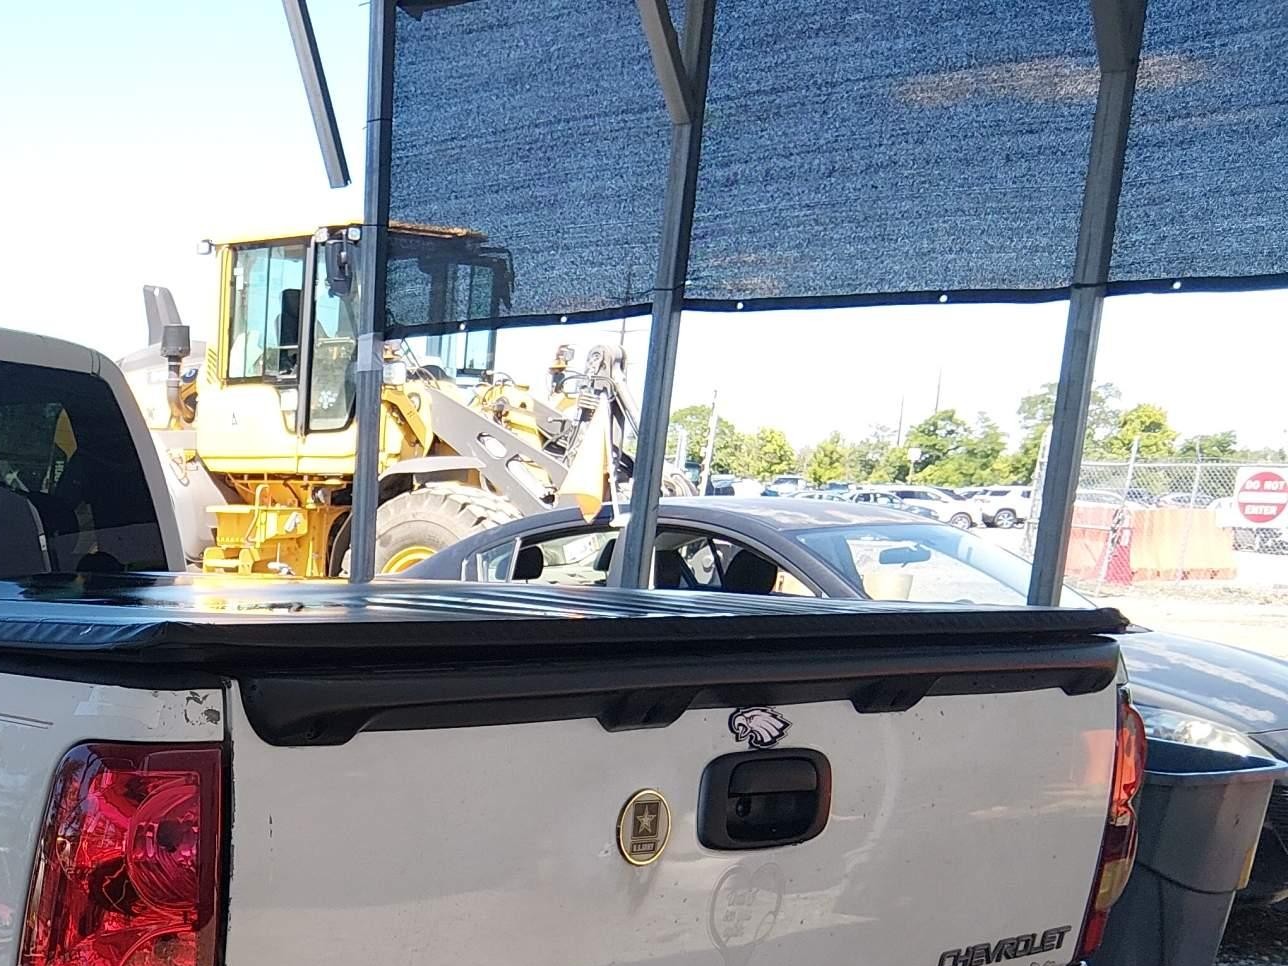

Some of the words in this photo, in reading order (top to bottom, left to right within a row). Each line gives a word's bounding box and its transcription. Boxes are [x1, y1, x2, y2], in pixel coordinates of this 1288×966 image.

[1245, 480, 1261, 490] DO
[1264, 480, 1287, 490] NOT
[1244, 504, 1277, 514] ENTER
